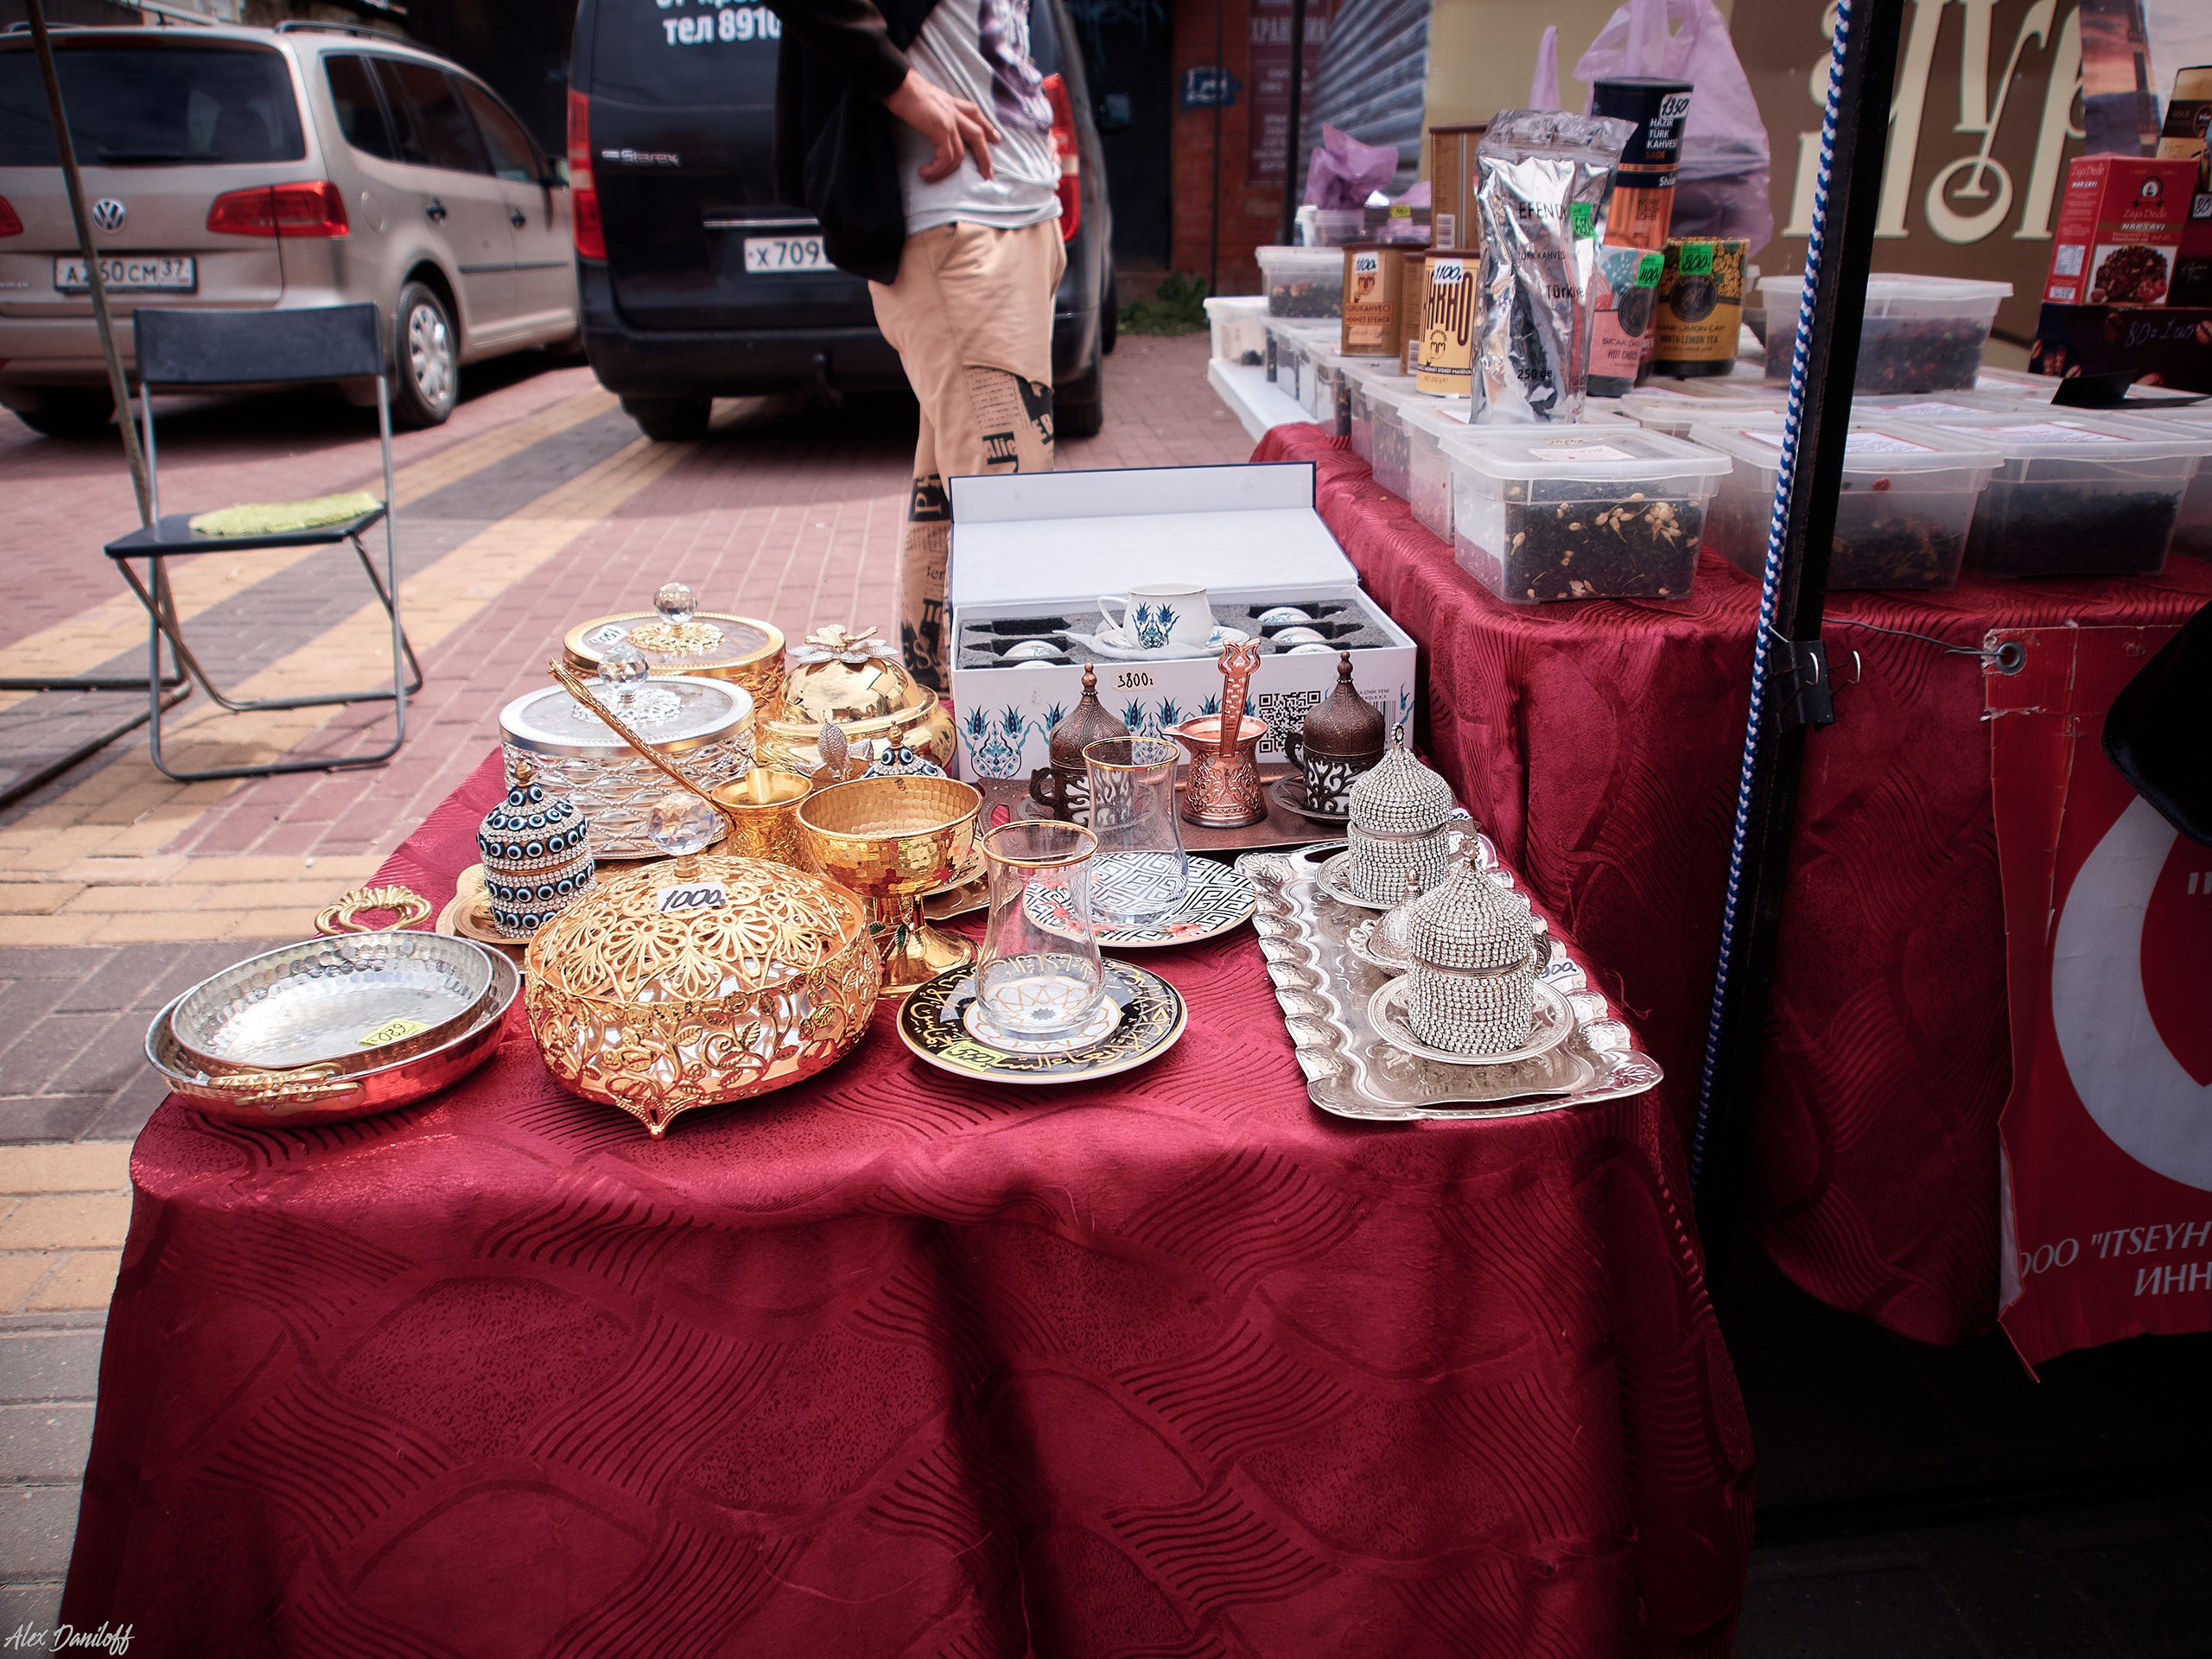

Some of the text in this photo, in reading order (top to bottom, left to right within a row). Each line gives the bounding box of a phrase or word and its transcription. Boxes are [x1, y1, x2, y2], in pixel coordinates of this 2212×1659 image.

[663, 16, 715, 47] тел
[1649, 127, 1669, 138] TÜRK
[620, 148, 682, 167] Starex
[1645, 149, 1666, 160] SADE
[162, 259, 183, 276] 37
[1602, 337, 1627, 346] SICAK
[1608, 349, 1621, 359] HOT
[1517, 368, 1537, 379] 250
